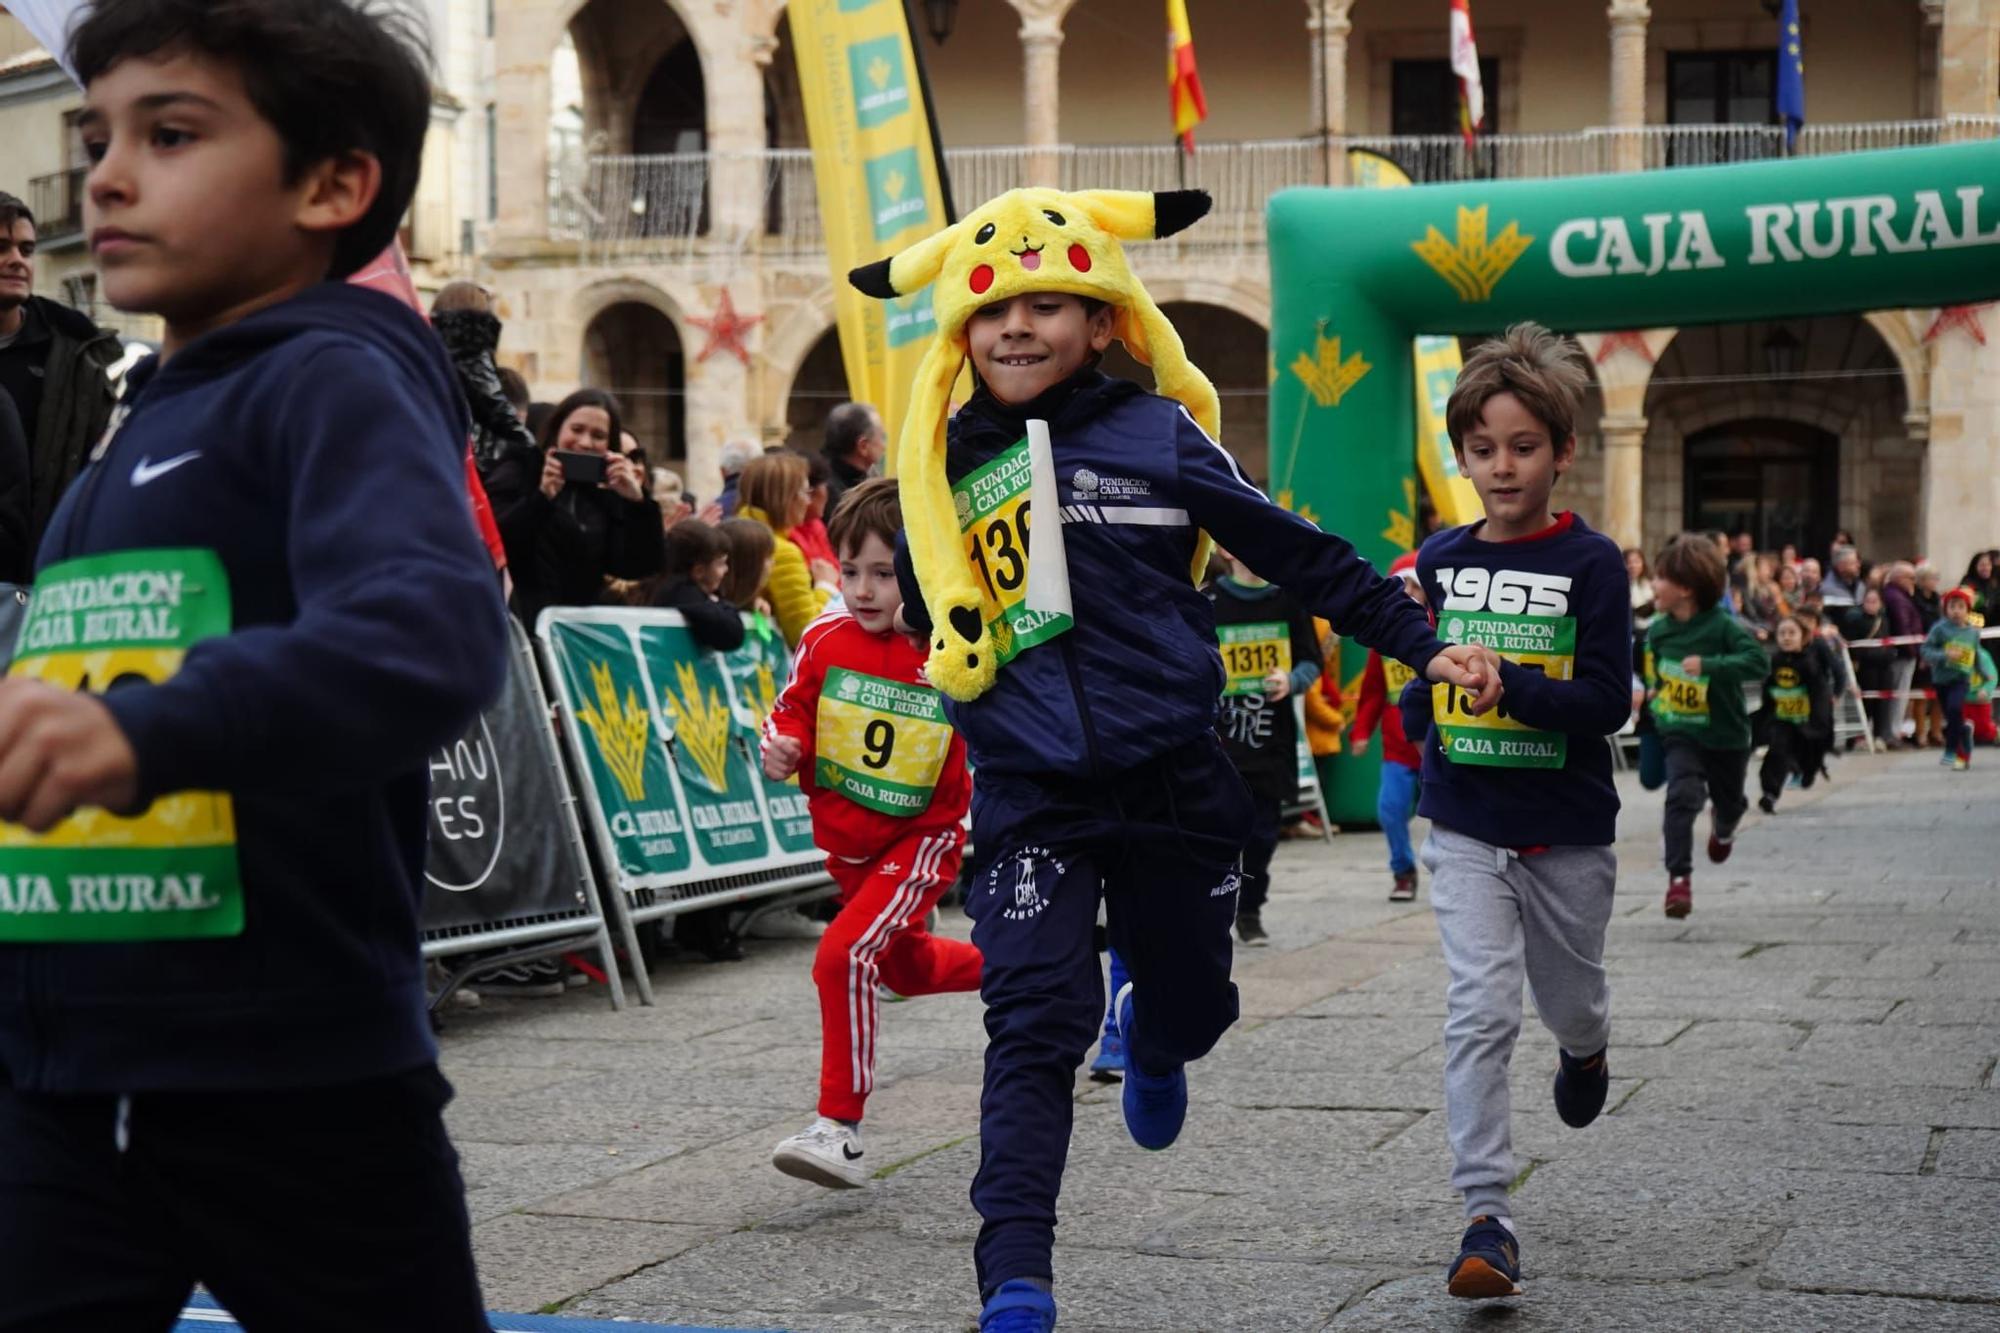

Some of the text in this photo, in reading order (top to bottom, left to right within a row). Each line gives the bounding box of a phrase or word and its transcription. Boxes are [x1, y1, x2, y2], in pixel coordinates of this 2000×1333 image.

[1549, 185, 2000, 278] CAJA RURAL
[970, 446, 1031, 500] FUNDAC
[975, 483, 1011, 514] CAJA
[1099, 486, 1121, 496] CAJA
[1435, 567, 1573, 617] 1965
[1467, 619, 1555, 638] FUNDACION
[1503, 636, 1555, 651] RURAL
[1226, 643, 1280, 674] 1313
[860, 693, 937, 719] CAJA RURAL
[862, 681, 939, 708] FUNDACION
[861, 719, 896, 770] 9
[1454, 736, 1558, 758] CAJA RURAL
[844, 777, 924, 808] CAJA RURAL
[67, 873, 221, 914] RURAL
[1003, 898, 1051, 921] ZAMORA
